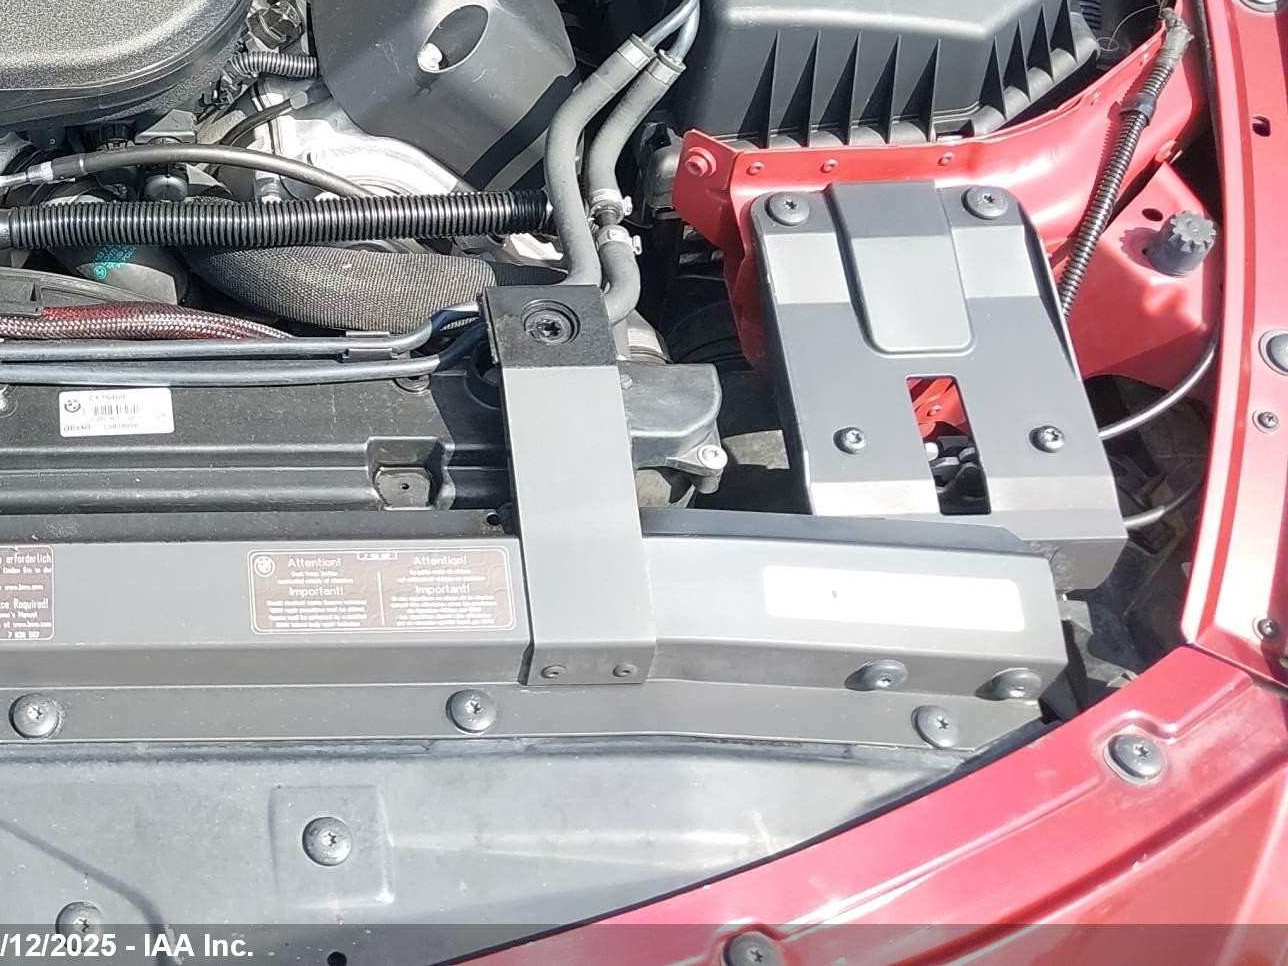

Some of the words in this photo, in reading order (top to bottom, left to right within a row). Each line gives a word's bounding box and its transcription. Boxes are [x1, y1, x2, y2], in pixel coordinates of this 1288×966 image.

[6, 552, 52, 564] erforderlich
[288, 557, 341, 568] Attention!
[289, 585, 344, 598] Important!
[13, 597, 49, 611] Required!
